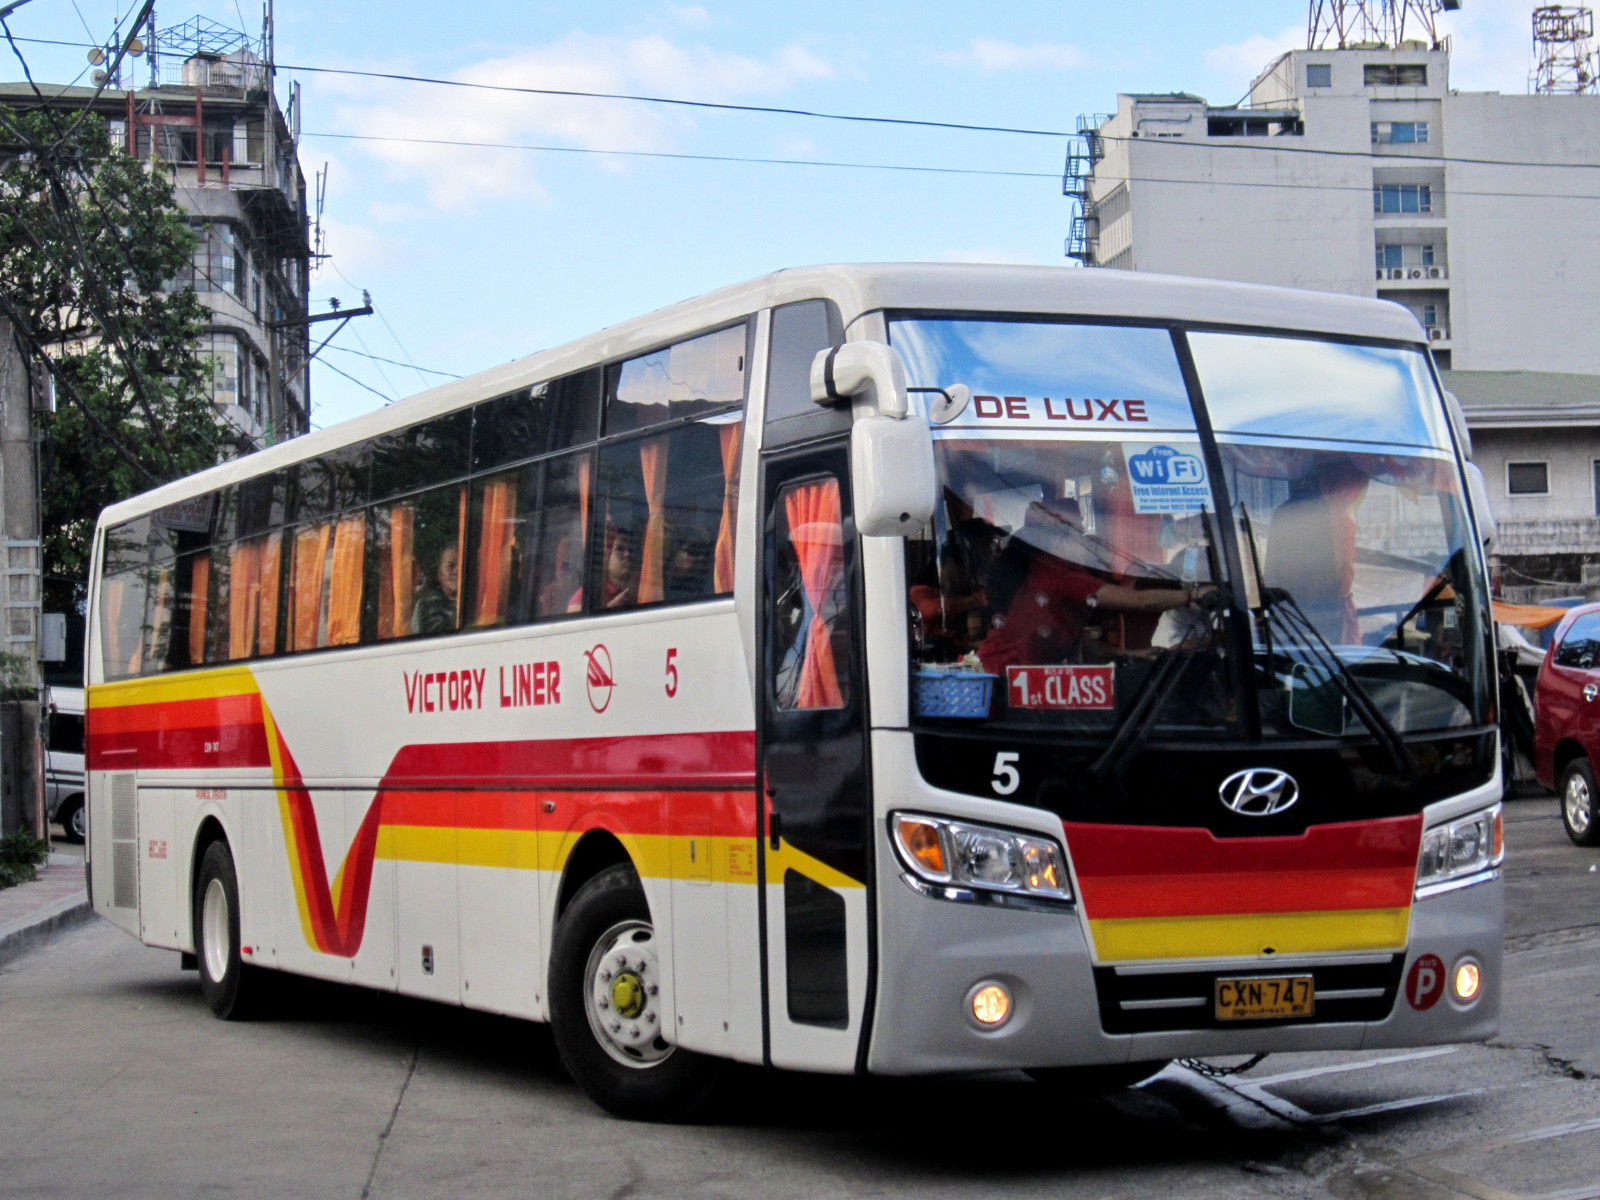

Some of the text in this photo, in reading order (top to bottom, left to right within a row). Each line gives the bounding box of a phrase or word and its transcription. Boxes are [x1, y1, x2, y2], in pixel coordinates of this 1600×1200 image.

[973, 395, 1149, 422] DE LUXE
[1152, 447, 1175, 457] Free
[1133, 486, 1209, 496] Free Internet Access
[403, 660, 561, 714] VICTORY LINER
[664, 647, 679, 699] 5
[1045, 675, 1107, 705] CLASS
[991, 751, 1020, 795] 5
[1414, 968, 1437, 1006] P
